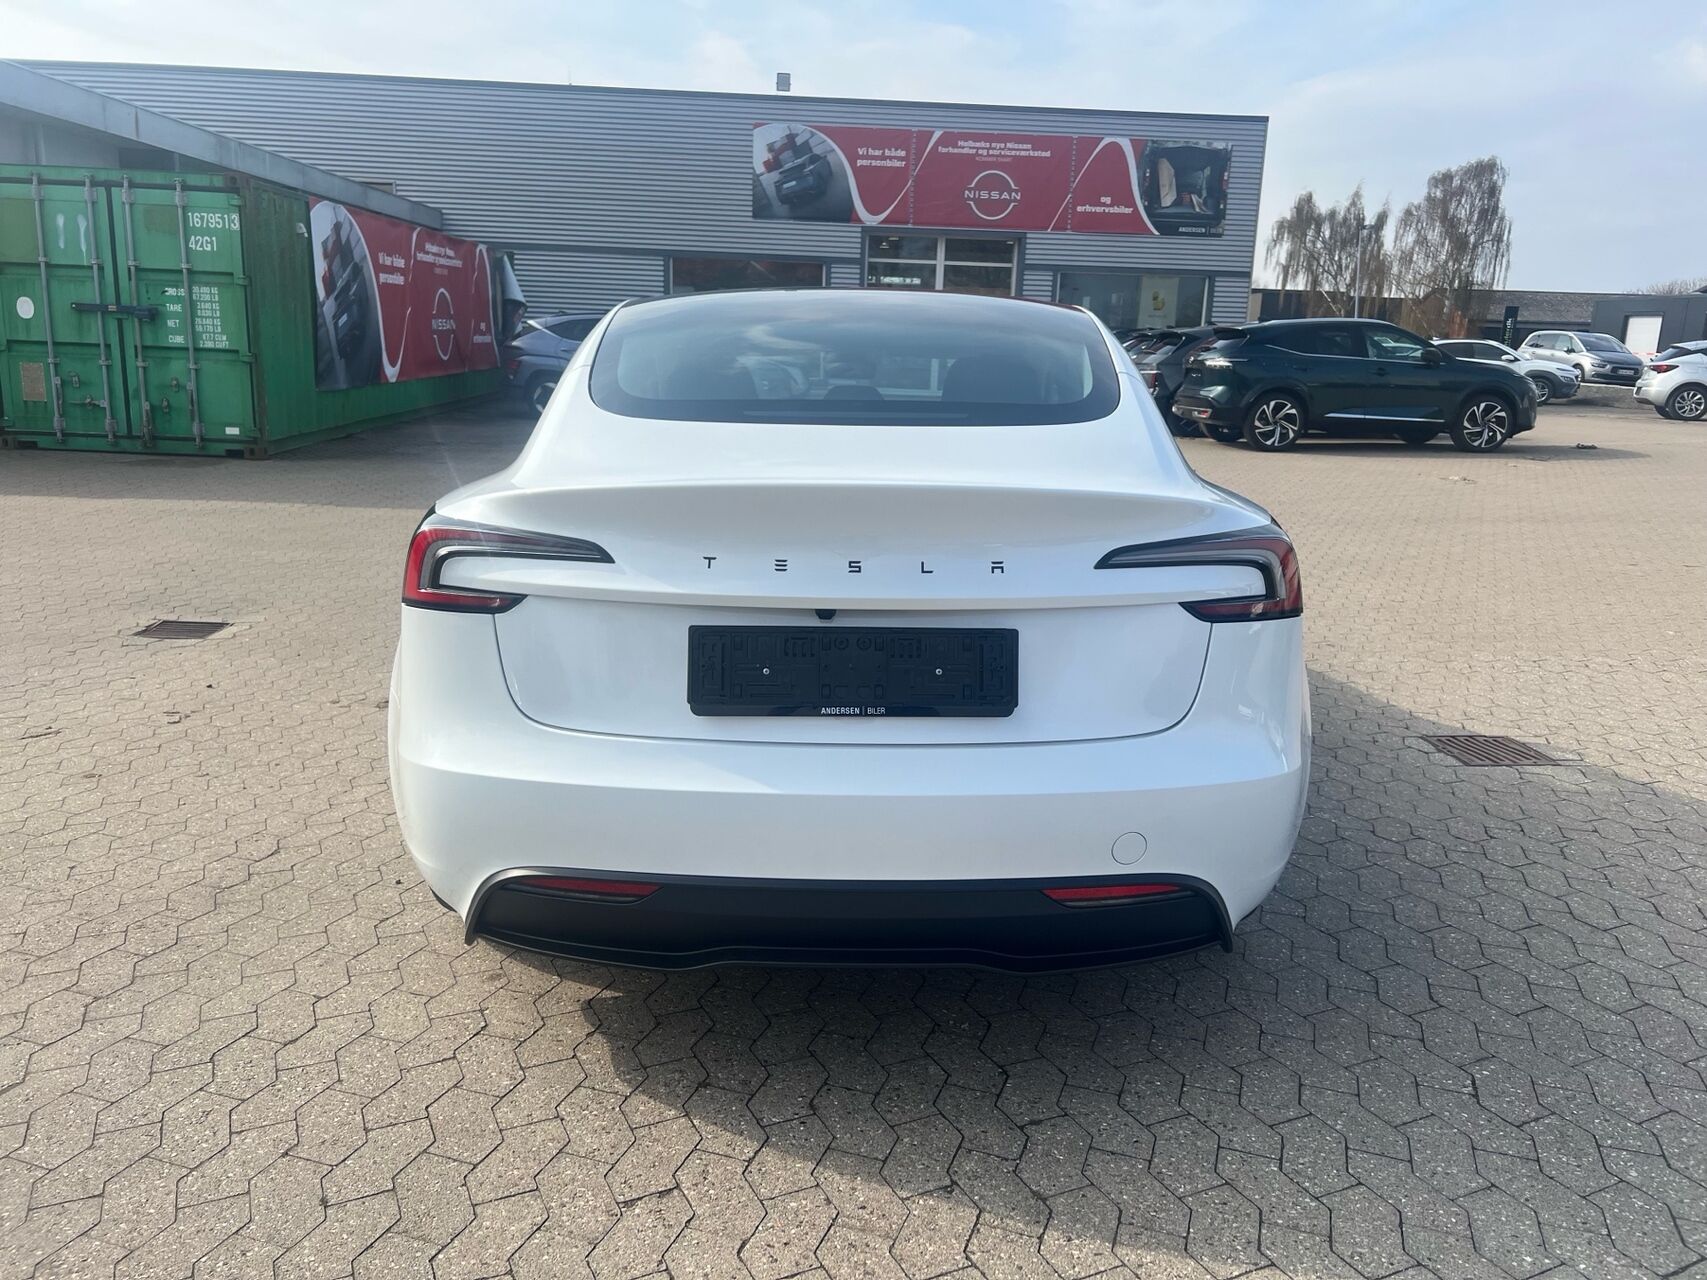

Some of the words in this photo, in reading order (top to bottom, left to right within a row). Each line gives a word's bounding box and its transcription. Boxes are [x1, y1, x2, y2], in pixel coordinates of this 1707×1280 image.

[857, 147, 868, 156] Vi
[868, 148, 883, 157] har
[885, 147, 907, 157] både
[856, 158, 907, 168] personbiler
[964, 189, 1021, 200] NISSAN
[1100, 195, 1112, 204] og
[187, 212, 240, 230] 1679513
[188, 235, 217, 252] 42G1
[165, 303, 183, 312] TARE
[167, 319, 180, 328] NET
[168, 335, 185, 344] CUBE
[702, 556, 1005, 574] TESLA
[820, 706, 860, 715] ANDERSEN
[867, 706, 886, 715] BILER
